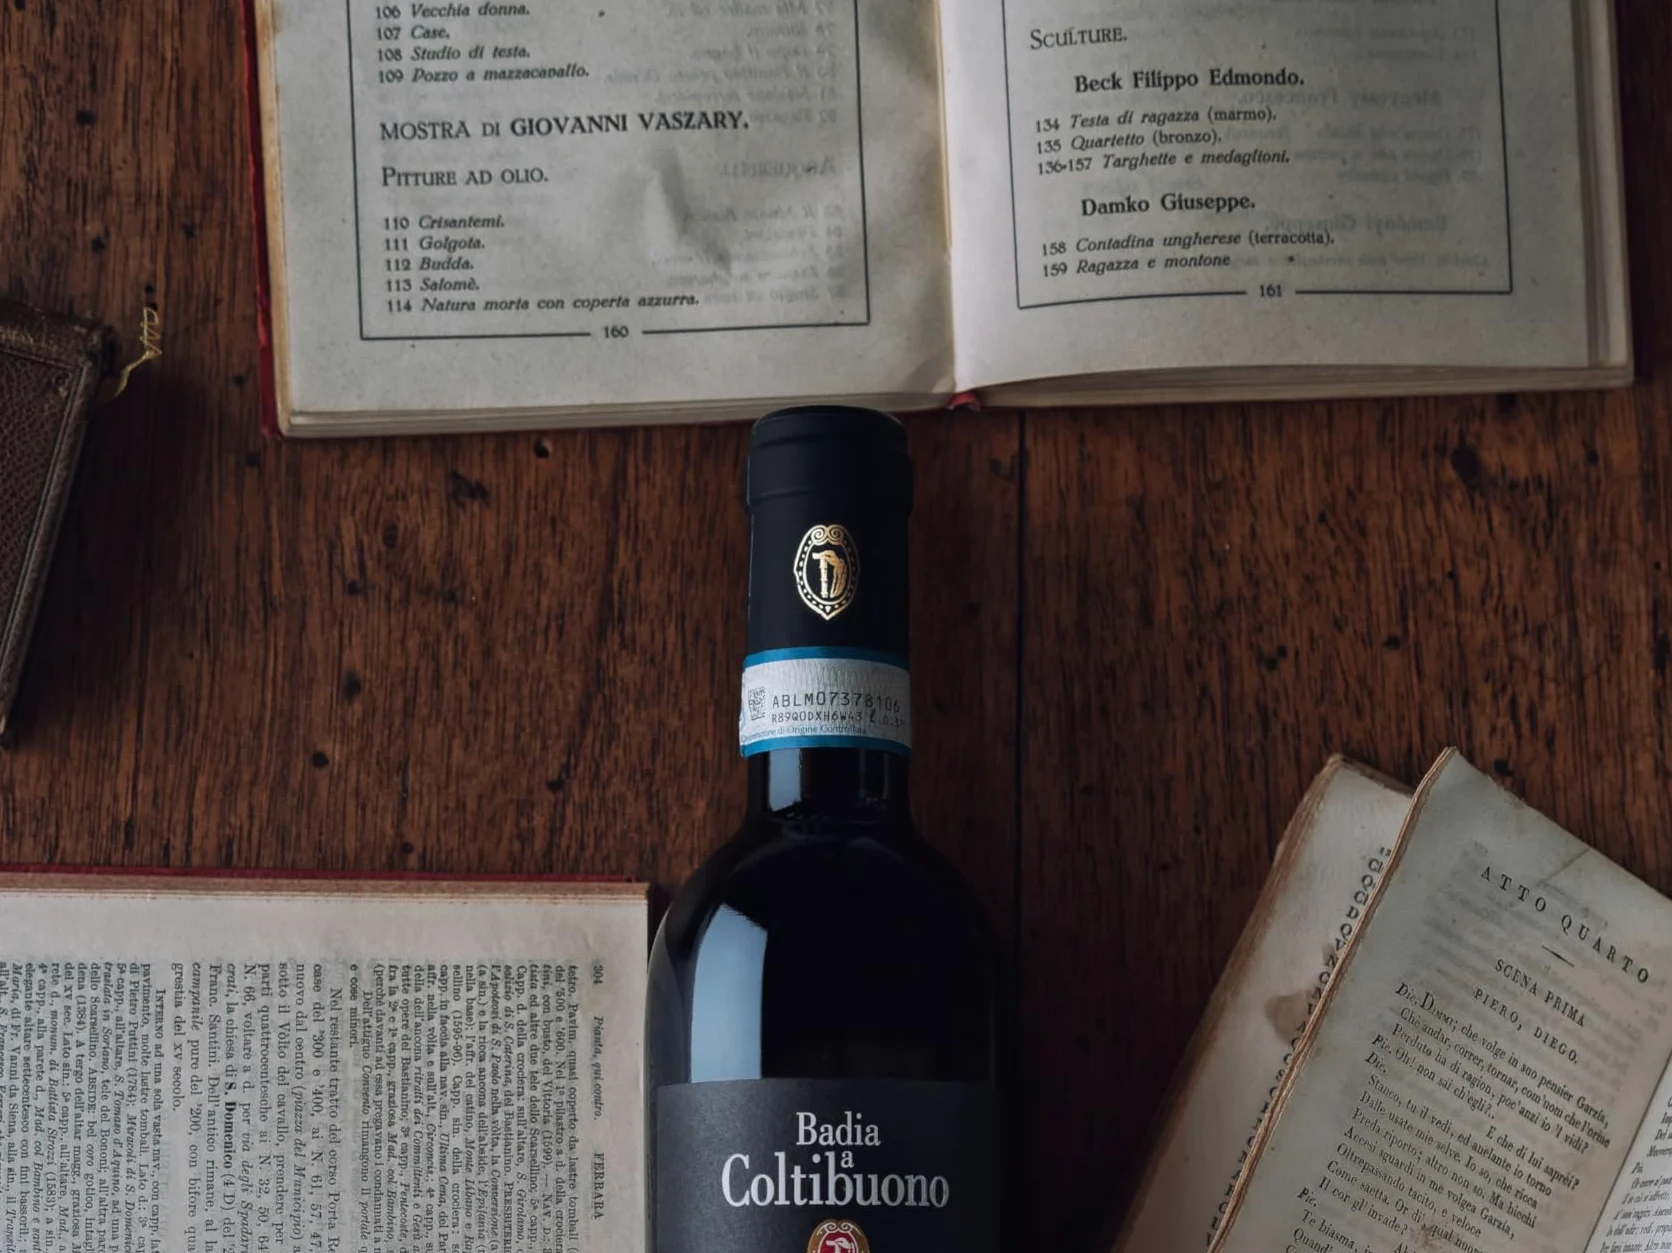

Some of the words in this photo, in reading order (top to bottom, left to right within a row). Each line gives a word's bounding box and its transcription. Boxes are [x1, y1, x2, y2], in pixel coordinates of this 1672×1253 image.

[376, 5, 401, 19] 106
[411, 3, 470, 18] Vecchia
[478, 1, 530, 16] donna.
[377, 26, 401, 40] 107
[410, 24, 450, 40] Case.
[378, 48, 403, 62] 108
[410, 45, 461, 61] Studio
[468, 45, 485, 59] di
[492, 46, 530, 59] testa.
[379, 69, 404, 84] 109
[411, 67, 459, 83] Pozzo
[466, 71, 475, 80] a
[483, 63, 589, 81] mazzacavallo.
[1075, 72, 1123, 93] Beck
[1132, 69, 1199, 92] Filippo
[1209, 67, 1304, 86] Edmondo.
[380, 120, 471, 141] MOSTRA
[510, 114, 628, 136] GIOVANNI
[639, 111, 749, 131] VASZARY.
[1036, 118, 1060, 133] 134
[1071, 114, 1110, 129] Testa
[1117, 110, 1134, 125] di
[1140, 111, 1199, 127] ragazza
[1207, 105, 1276, 125] (marmo).
[1037, 139, 1062, 155] 135
[1071, 133, 1145, 152] Quartetto
[1152, 128, 1222, 147] (bronzo).
[1103, 152, 1177, 171] Targhette
[1184, 154, 1193, 164] e
[1200, 148, 1290, 167] medaglioni.
[1081, 195, 1150, 216] Damko
[1160, 192, 1255, 214] Giuseppe.
[384, 216, 410, 230] 110
[418, 214, 505, 230] Crisantemi.
[385, 237, 408, 251] 111
[419, 235, 485, 254] Golgota.
[1042, 241, 1067, 257] 158
[1076, 234, 1154, 252] Contadina
[1163, 232, 1241, 250] ungherese
[1248, 228, 1334, 248] (terracotta).
[386, 258, 411, 271] 112
[419, 256, 474, 271] Budda.
[1043, 262, 1068, 277] 159
[1076, 259, 1139, 276] Ragazza
[1147, 259, 1156, 268] e
[1164, 254, 1231, 268] montone
[387, 278, 412, 292] 113
[420, 277, 480, 292] Salomè.
[1260, 284, 1282, 298] 161
[388, 299, 412, 312] 114
[421, 297, 476, 312] Natura
[483, 297, 529, 311] morta
[537, 299, 565, 309] con
[572, 295, 630, 312] coperta
[638, 295, 699, 307] azzurra.
[604, 325, 629, 338] 160
[787, 725, 818, 735] Origine
[1481, 866, 1546, 912] ATTO
[1561, 914, 1649, 983] QUARTO
[1495, 959, 1537, 996] SCENA
[1544, 990, 1584, 1027] PRIMA
[1474, 987, 1522, 1031] PIERO,
[1533, 1026, 1577, 1065] DIEGO.
[1460, 1023, 1478, 1042] che
[1482, 1037, 1506, 1060] volge
[1507, 1052, 1519, 1068] in
[1520, 1064, 1537, 1079] suo
[1537, 1075, 1574, 1102] pensier
[796, 1111, 881, 1146] Badia
[841, 1151, 854, 1168] a
[593, 1153, 605, 1219] FERRARA
[721, 1150, 949, 1208] Coltibuono
